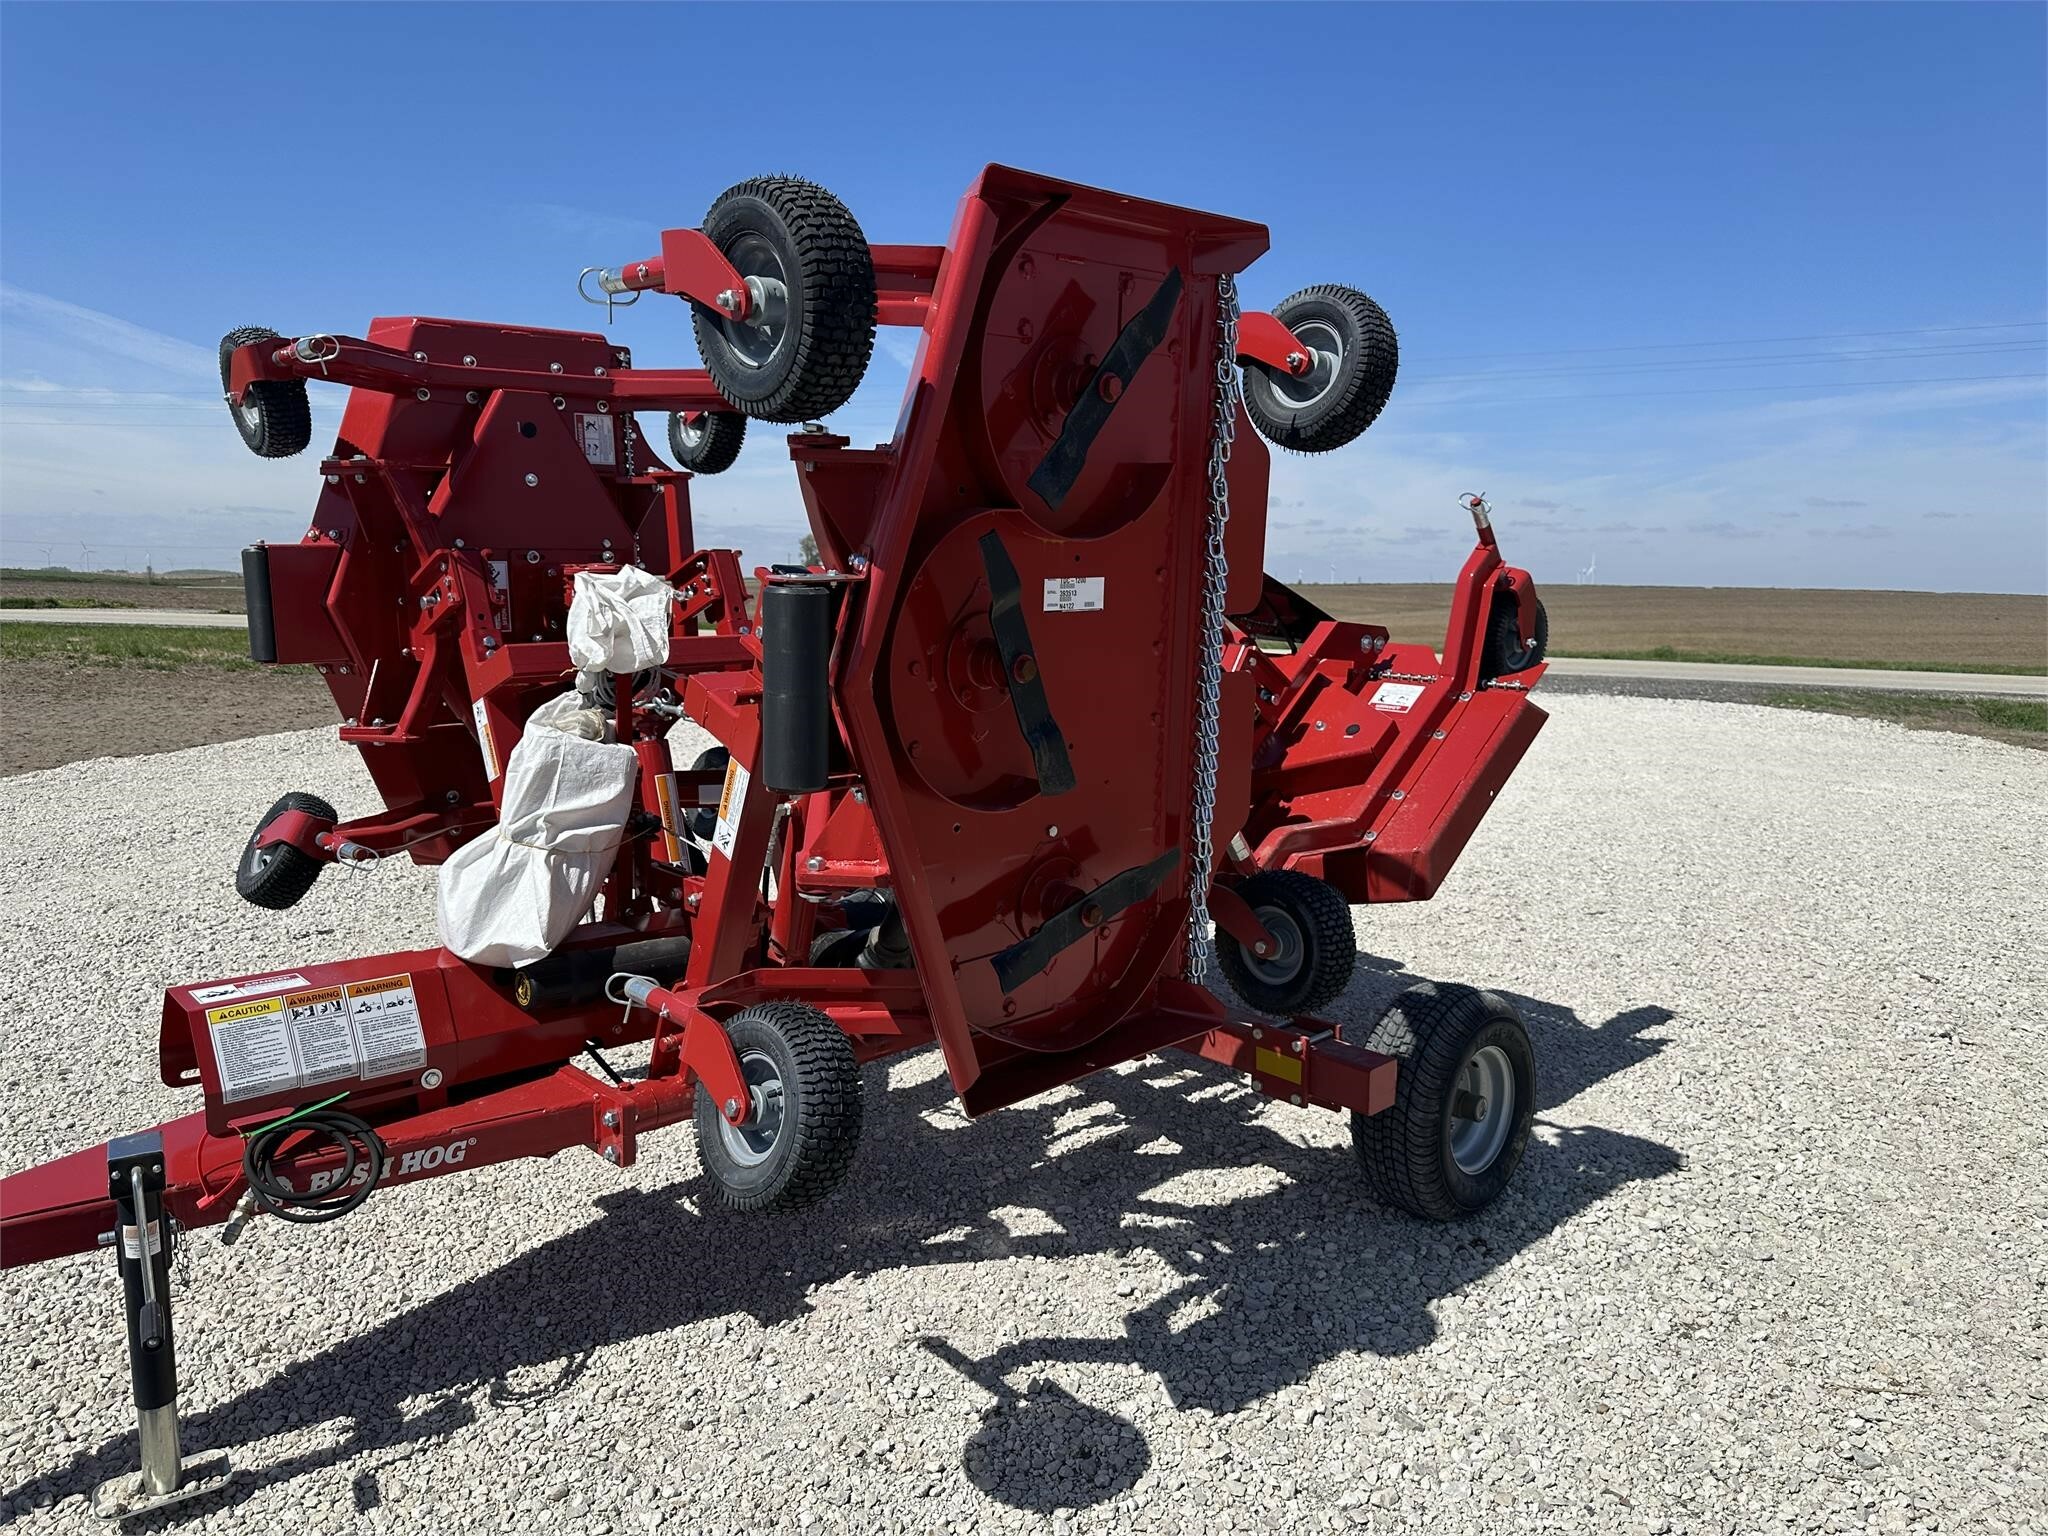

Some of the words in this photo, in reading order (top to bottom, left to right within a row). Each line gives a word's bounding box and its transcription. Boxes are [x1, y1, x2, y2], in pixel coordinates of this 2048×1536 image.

[723, 769, 735, 804] WARNING
[363, 979, 403, 993] WARNING
[297, 990, 340, 1004] WARNING
[227, 1003, 271, 1018] CAUTION
